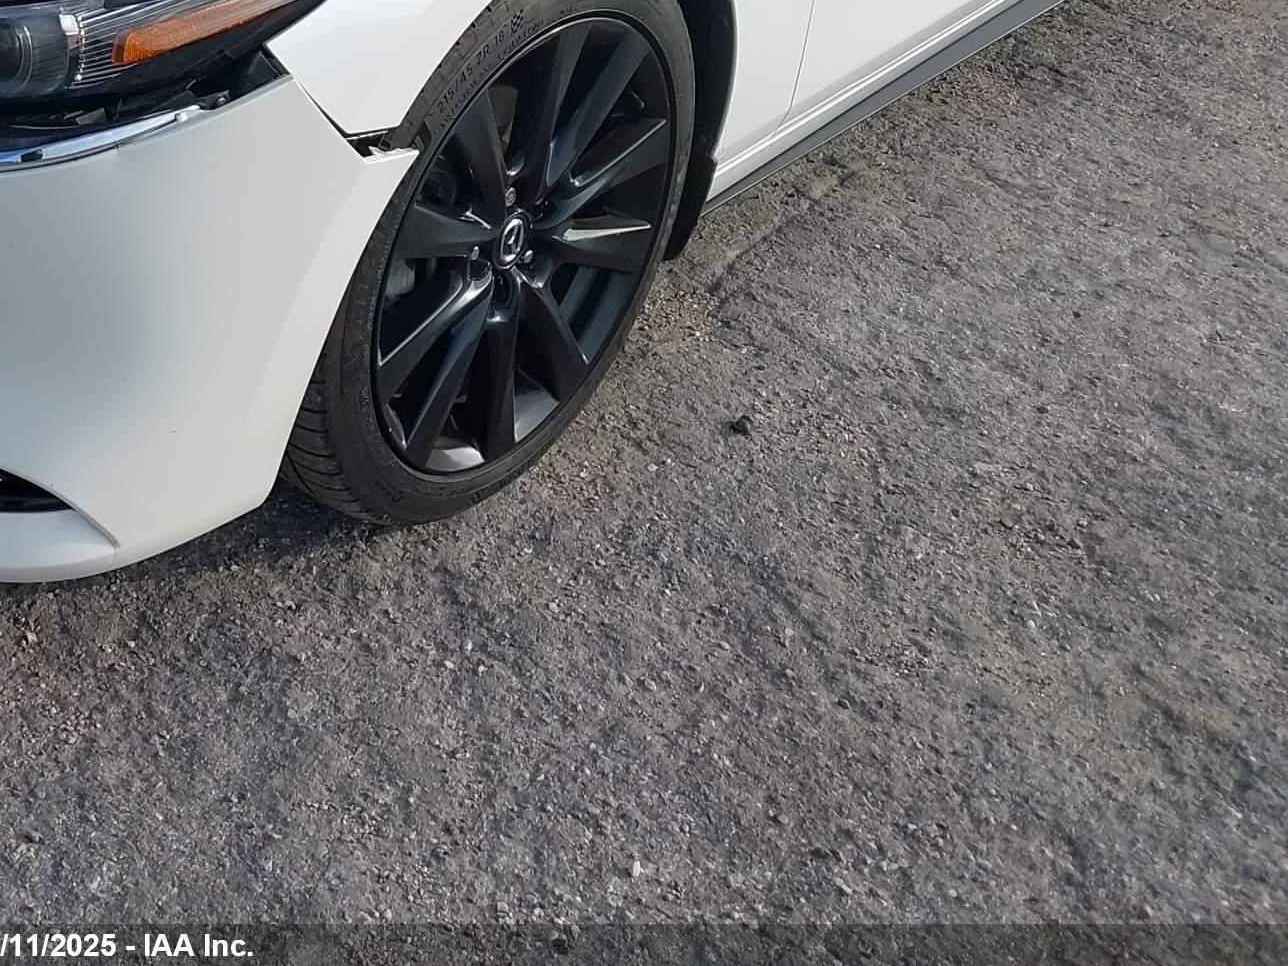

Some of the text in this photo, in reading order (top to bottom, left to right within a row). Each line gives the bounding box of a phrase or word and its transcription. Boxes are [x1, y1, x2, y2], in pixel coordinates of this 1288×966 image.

[437, 30, 505, 114] 215/45 ZR 18
